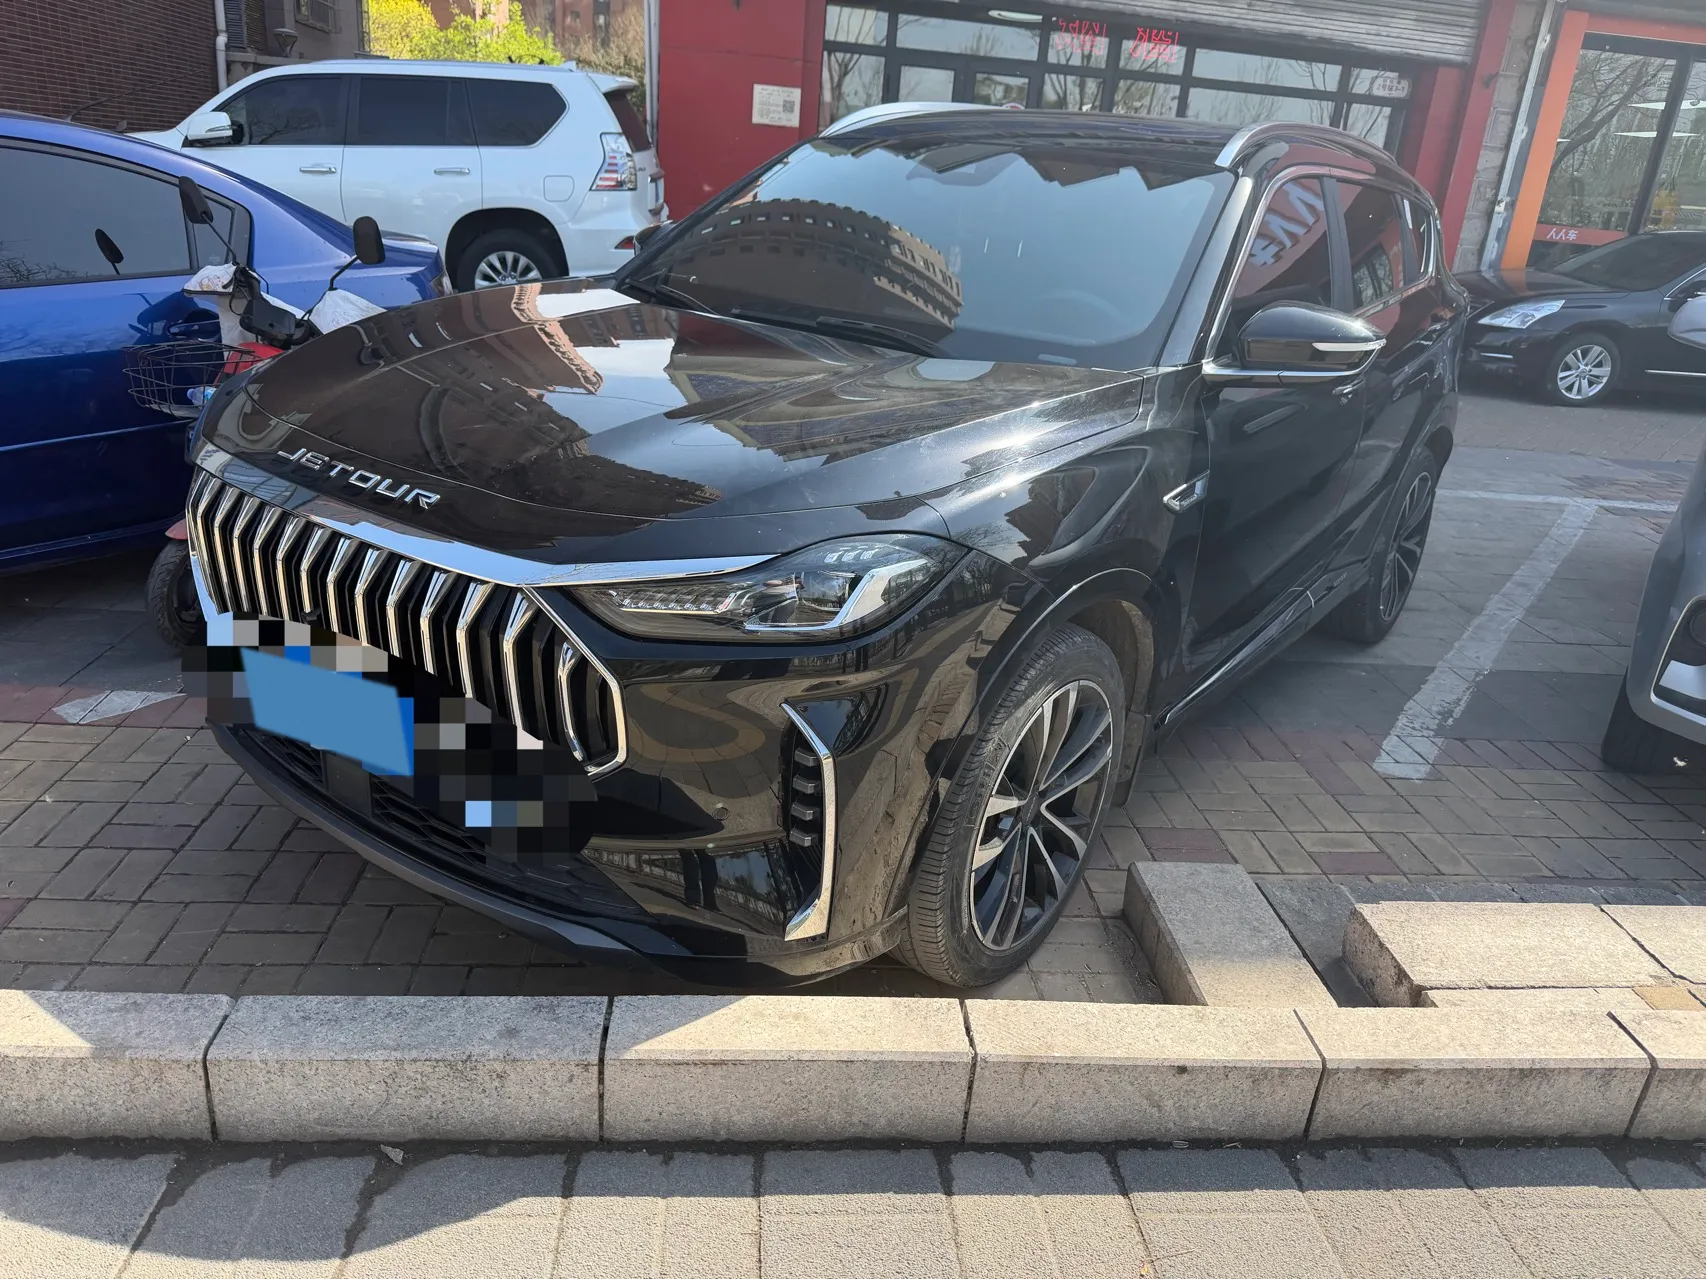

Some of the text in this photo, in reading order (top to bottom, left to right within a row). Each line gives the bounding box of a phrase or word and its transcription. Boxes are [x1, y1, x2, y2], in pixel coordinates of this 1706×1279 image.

[1546, 228, 1578, 240] 人人车
[277, 448, 441, 510] JETOUR
